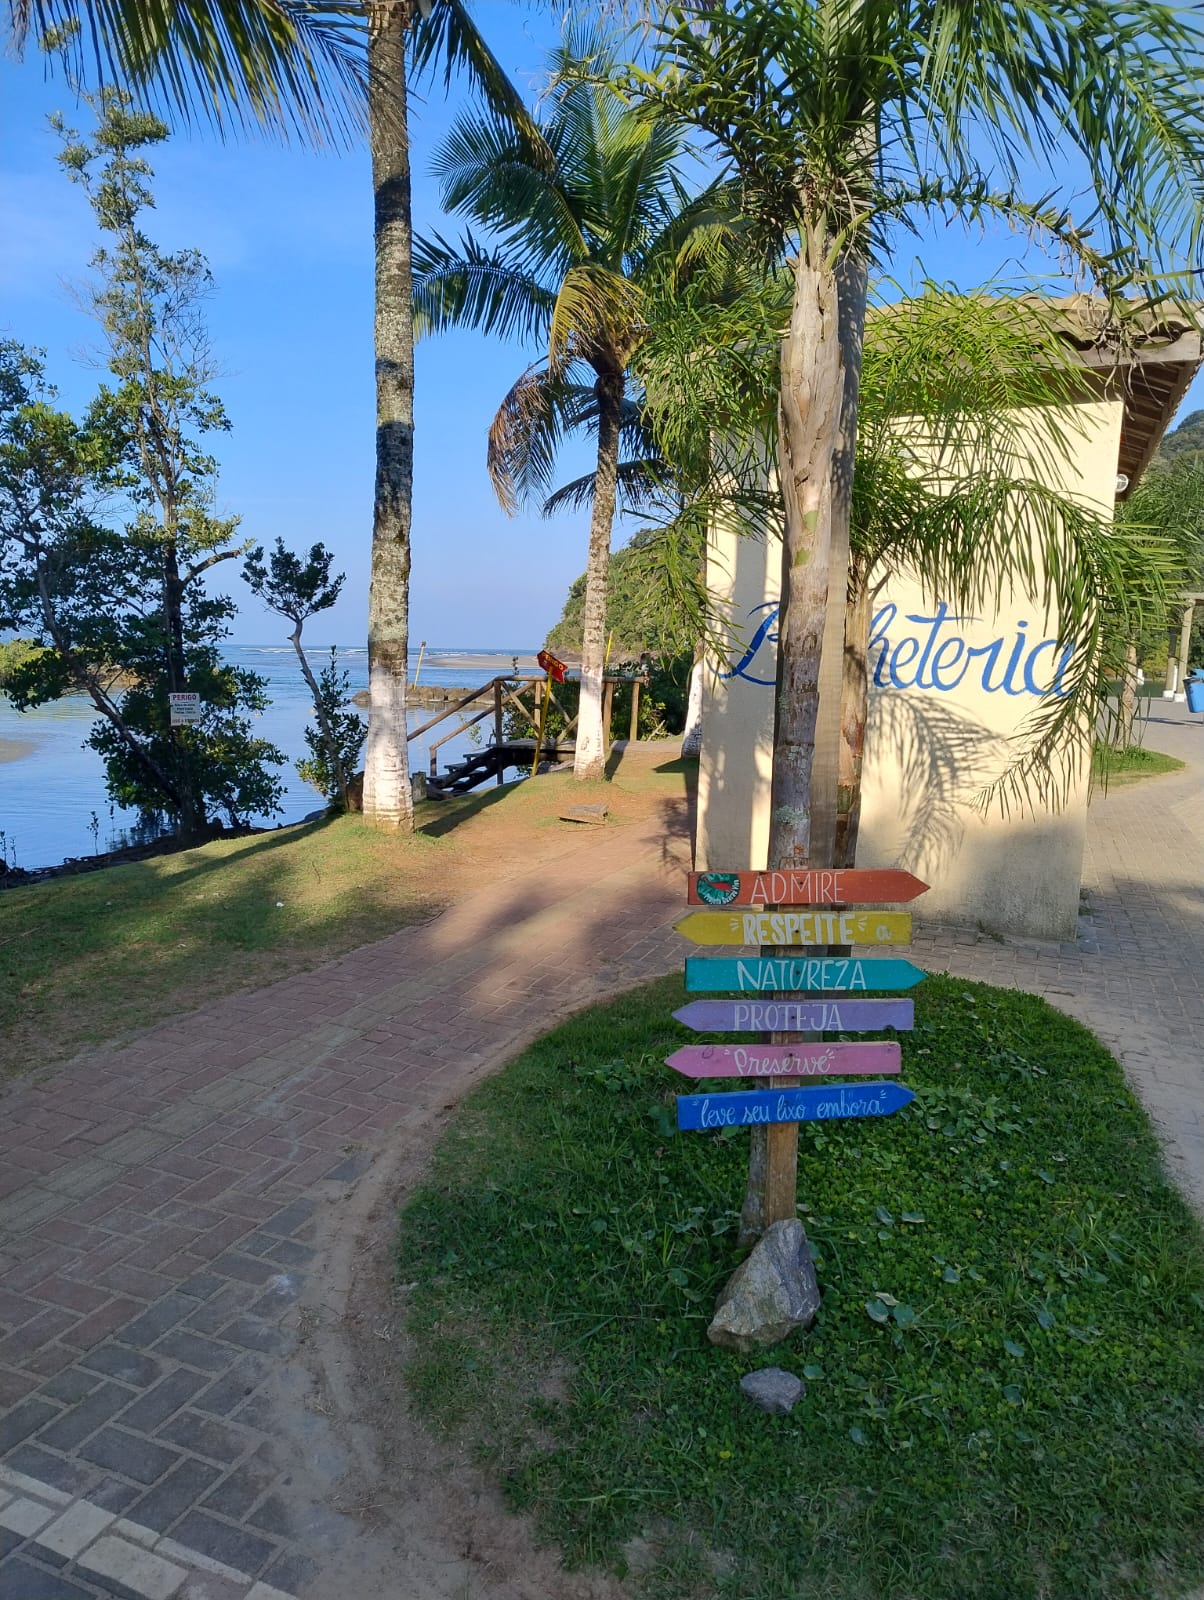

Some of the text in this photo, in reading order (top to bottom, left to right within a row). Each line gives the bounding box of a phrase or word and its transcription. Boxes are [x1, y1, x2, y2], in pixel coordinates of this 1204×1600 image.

[750, 871, 846, 904] ADMIRE
[742, 913, 856, 946] RESPEITE
[736, 960, 867, 991] NATUREZA
[732, 1003, 845, 1031] PROTEJA
[734, 1048, 831, 1076] Preserve
[700, 1089, 885, 1128] leve seu lixo embora
